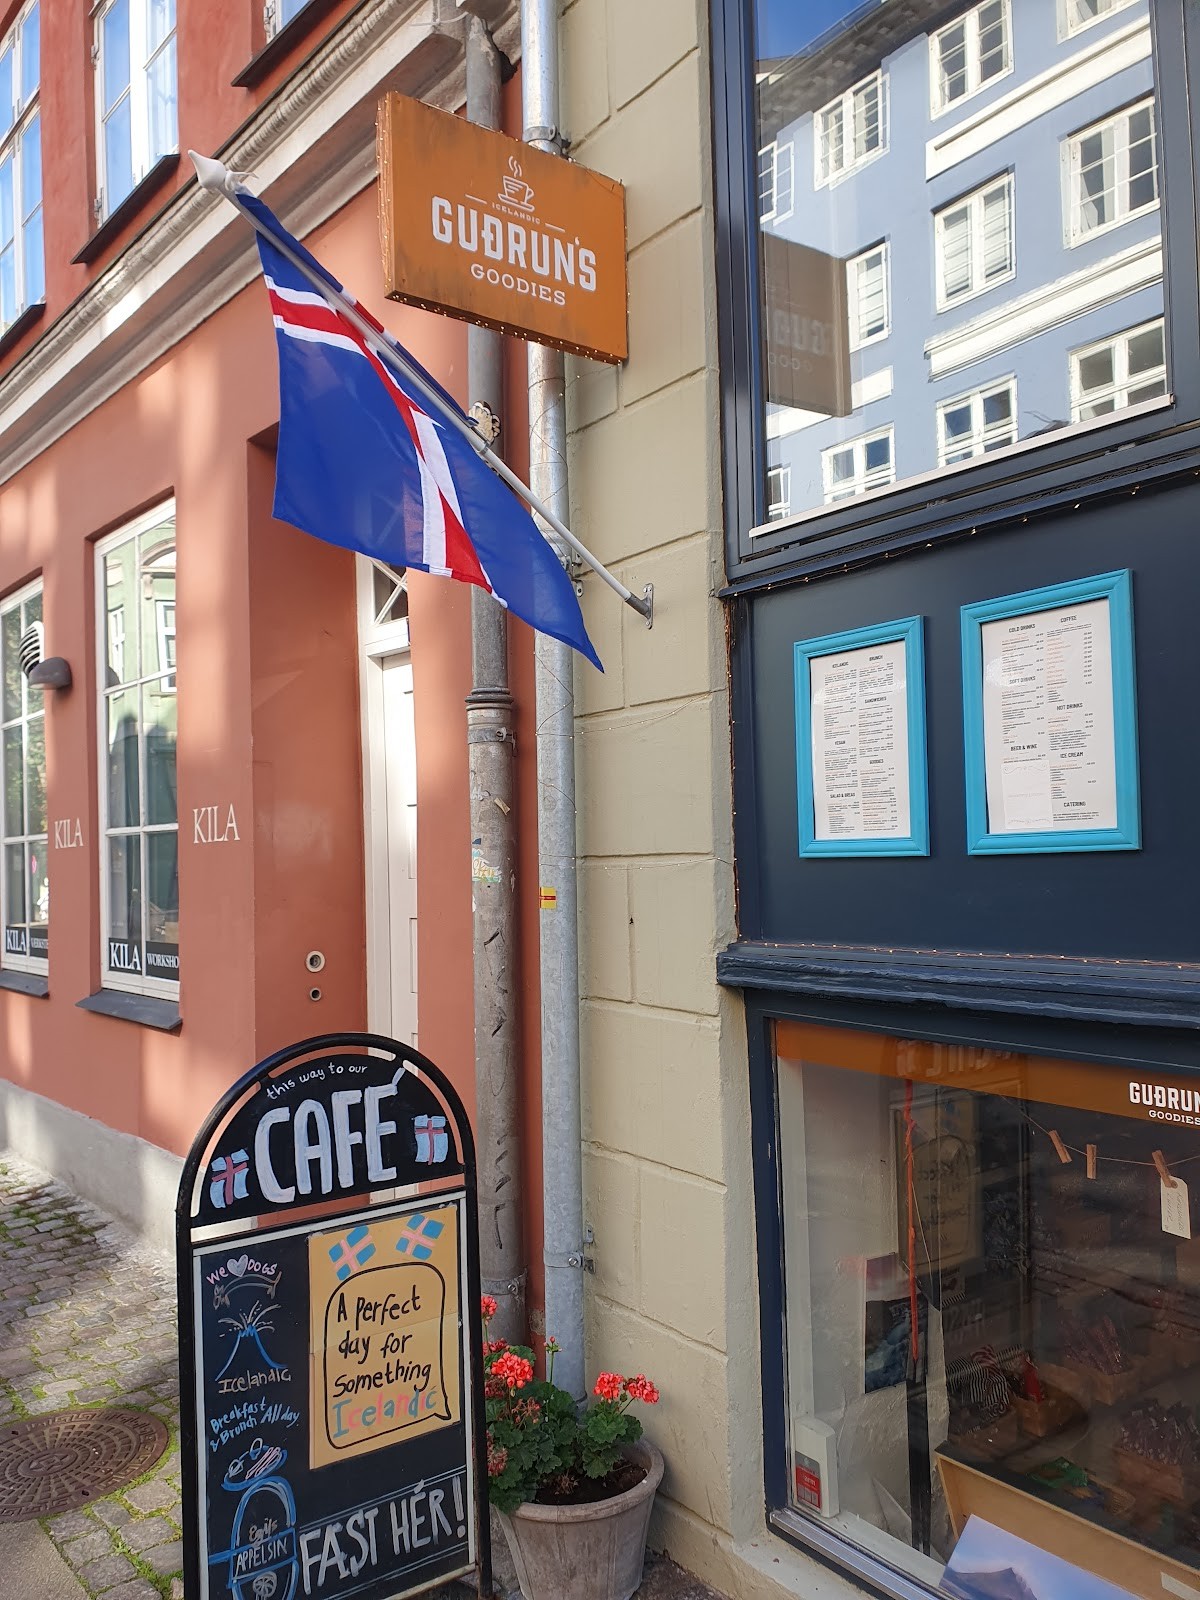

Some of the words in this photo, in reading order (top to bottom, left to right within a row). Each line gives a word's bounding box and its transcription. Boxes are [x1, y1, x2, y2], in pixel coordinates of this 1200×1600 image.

[491, 201, 541, 225] ICELANDIC
[470, 263, 566, 306] GOODIES
[54, 817, 84, 849] KILA
[192, 803, 240, 844] KILA
[7, 929, 26, 952] KILA
[110, 942, 142, 971] KILA
[266, 1080, 296, 1100] this
[299, 1067, 326, 1083] way
[328, 1062, 344, 1074] to
[348, 1065, 368, 1074] our
[1148, 1109, 1200, 1126] GOODIES
[255, 1067, 406, 1203] CAFÉ
[247, 1258, 278, 1276] DOGS
[337, 1292, 348, 1323] A
[338, 1330, 371, 1365] day
[380, 1332, 413, 1359] for
[218, 1368, 291, 1394] Icelandic
[210, 1396, 267, 1434] Breakfast
[260, 1403, 282, 1424] All
[332, 1388, 438, 1439] Icelandic
[220, 1415, 258, 1445] Brunch
[234, 1537, 289, 1578] APPELSIN
